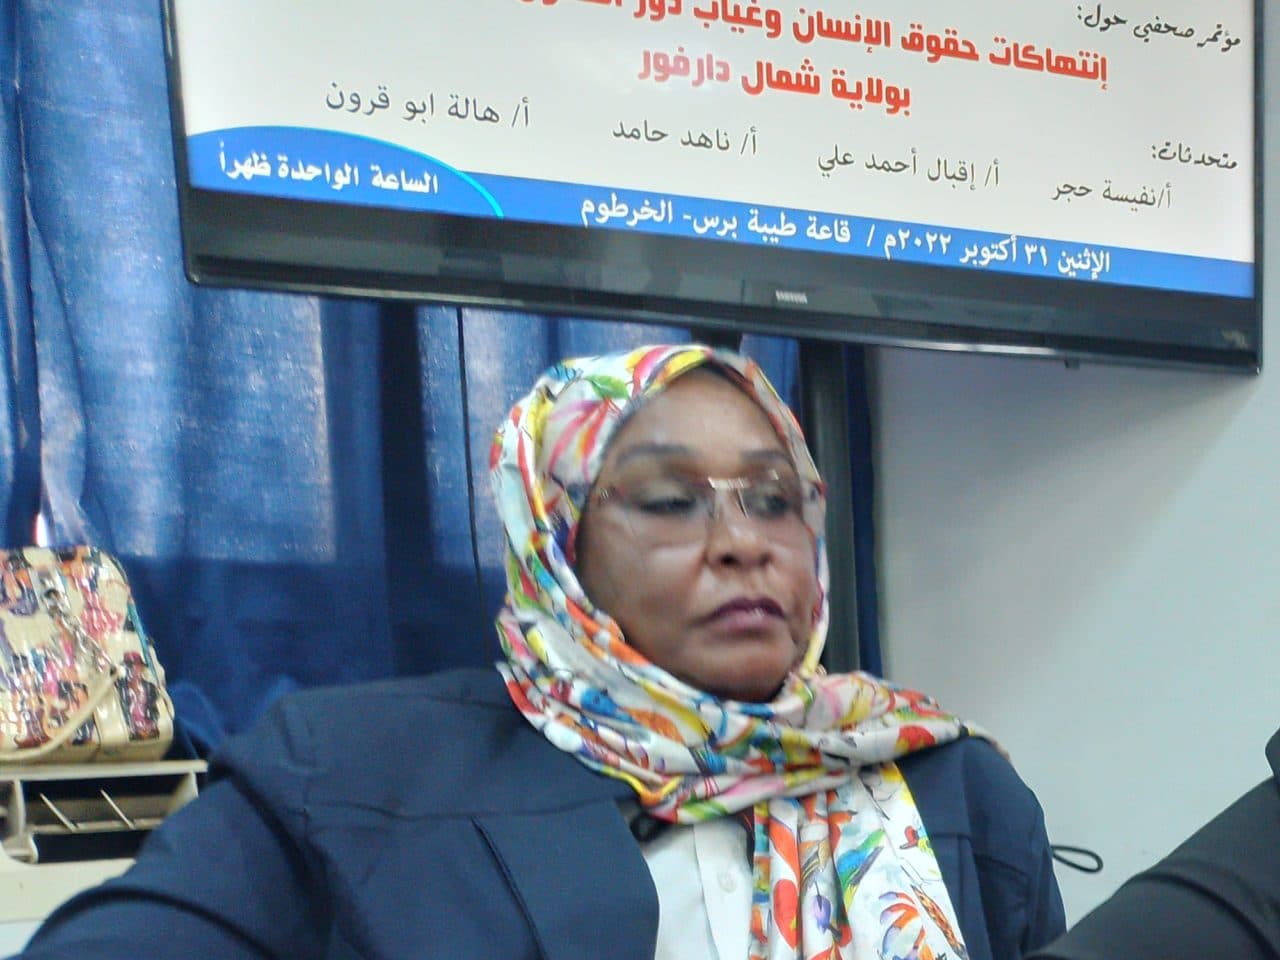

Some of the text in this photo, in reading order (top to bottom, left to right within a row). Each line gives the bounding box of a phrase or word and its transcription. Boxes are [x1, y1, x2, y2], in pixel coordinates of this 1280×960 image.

[694, 0, 782, 39] وغياب
[791, 6, 891, 53] الإنسان
[1132, 14, 1195, 41] صحفي
[901, 23, 979, 63] حقوق
[1197, 21, 1241, 52] مؤتمر
[988, 38, 1108, 89] إنتهاكات
[638, 46, 911, 116] بولاية شمال دارفور
[324, 81, 391, 115] قرون
[402, 93, 434, 123] ابو
[447, 92, 501, 124] هالة
[611, 120, 669, 144] حامد
[680, 126, 731, 152] ناهد
[276, 157, 359, 190] الواحدة
[816, 144, 855, 178] علي
[864, 148, 918, 176] أحمد
[926, 157, 976, 190] إقبال
[370, 164, 439, 196] الساعة
[1052, 180, 1093, 202] حجر
[580, 197, 672, 229] الخرطوم
[746, 211, 797, 247] طيبة
[805, 215, 851, 245] قاعة
[959, 235, 1018, 267] أكتوبر
[1023, 245, 1048, 267] ٣١
